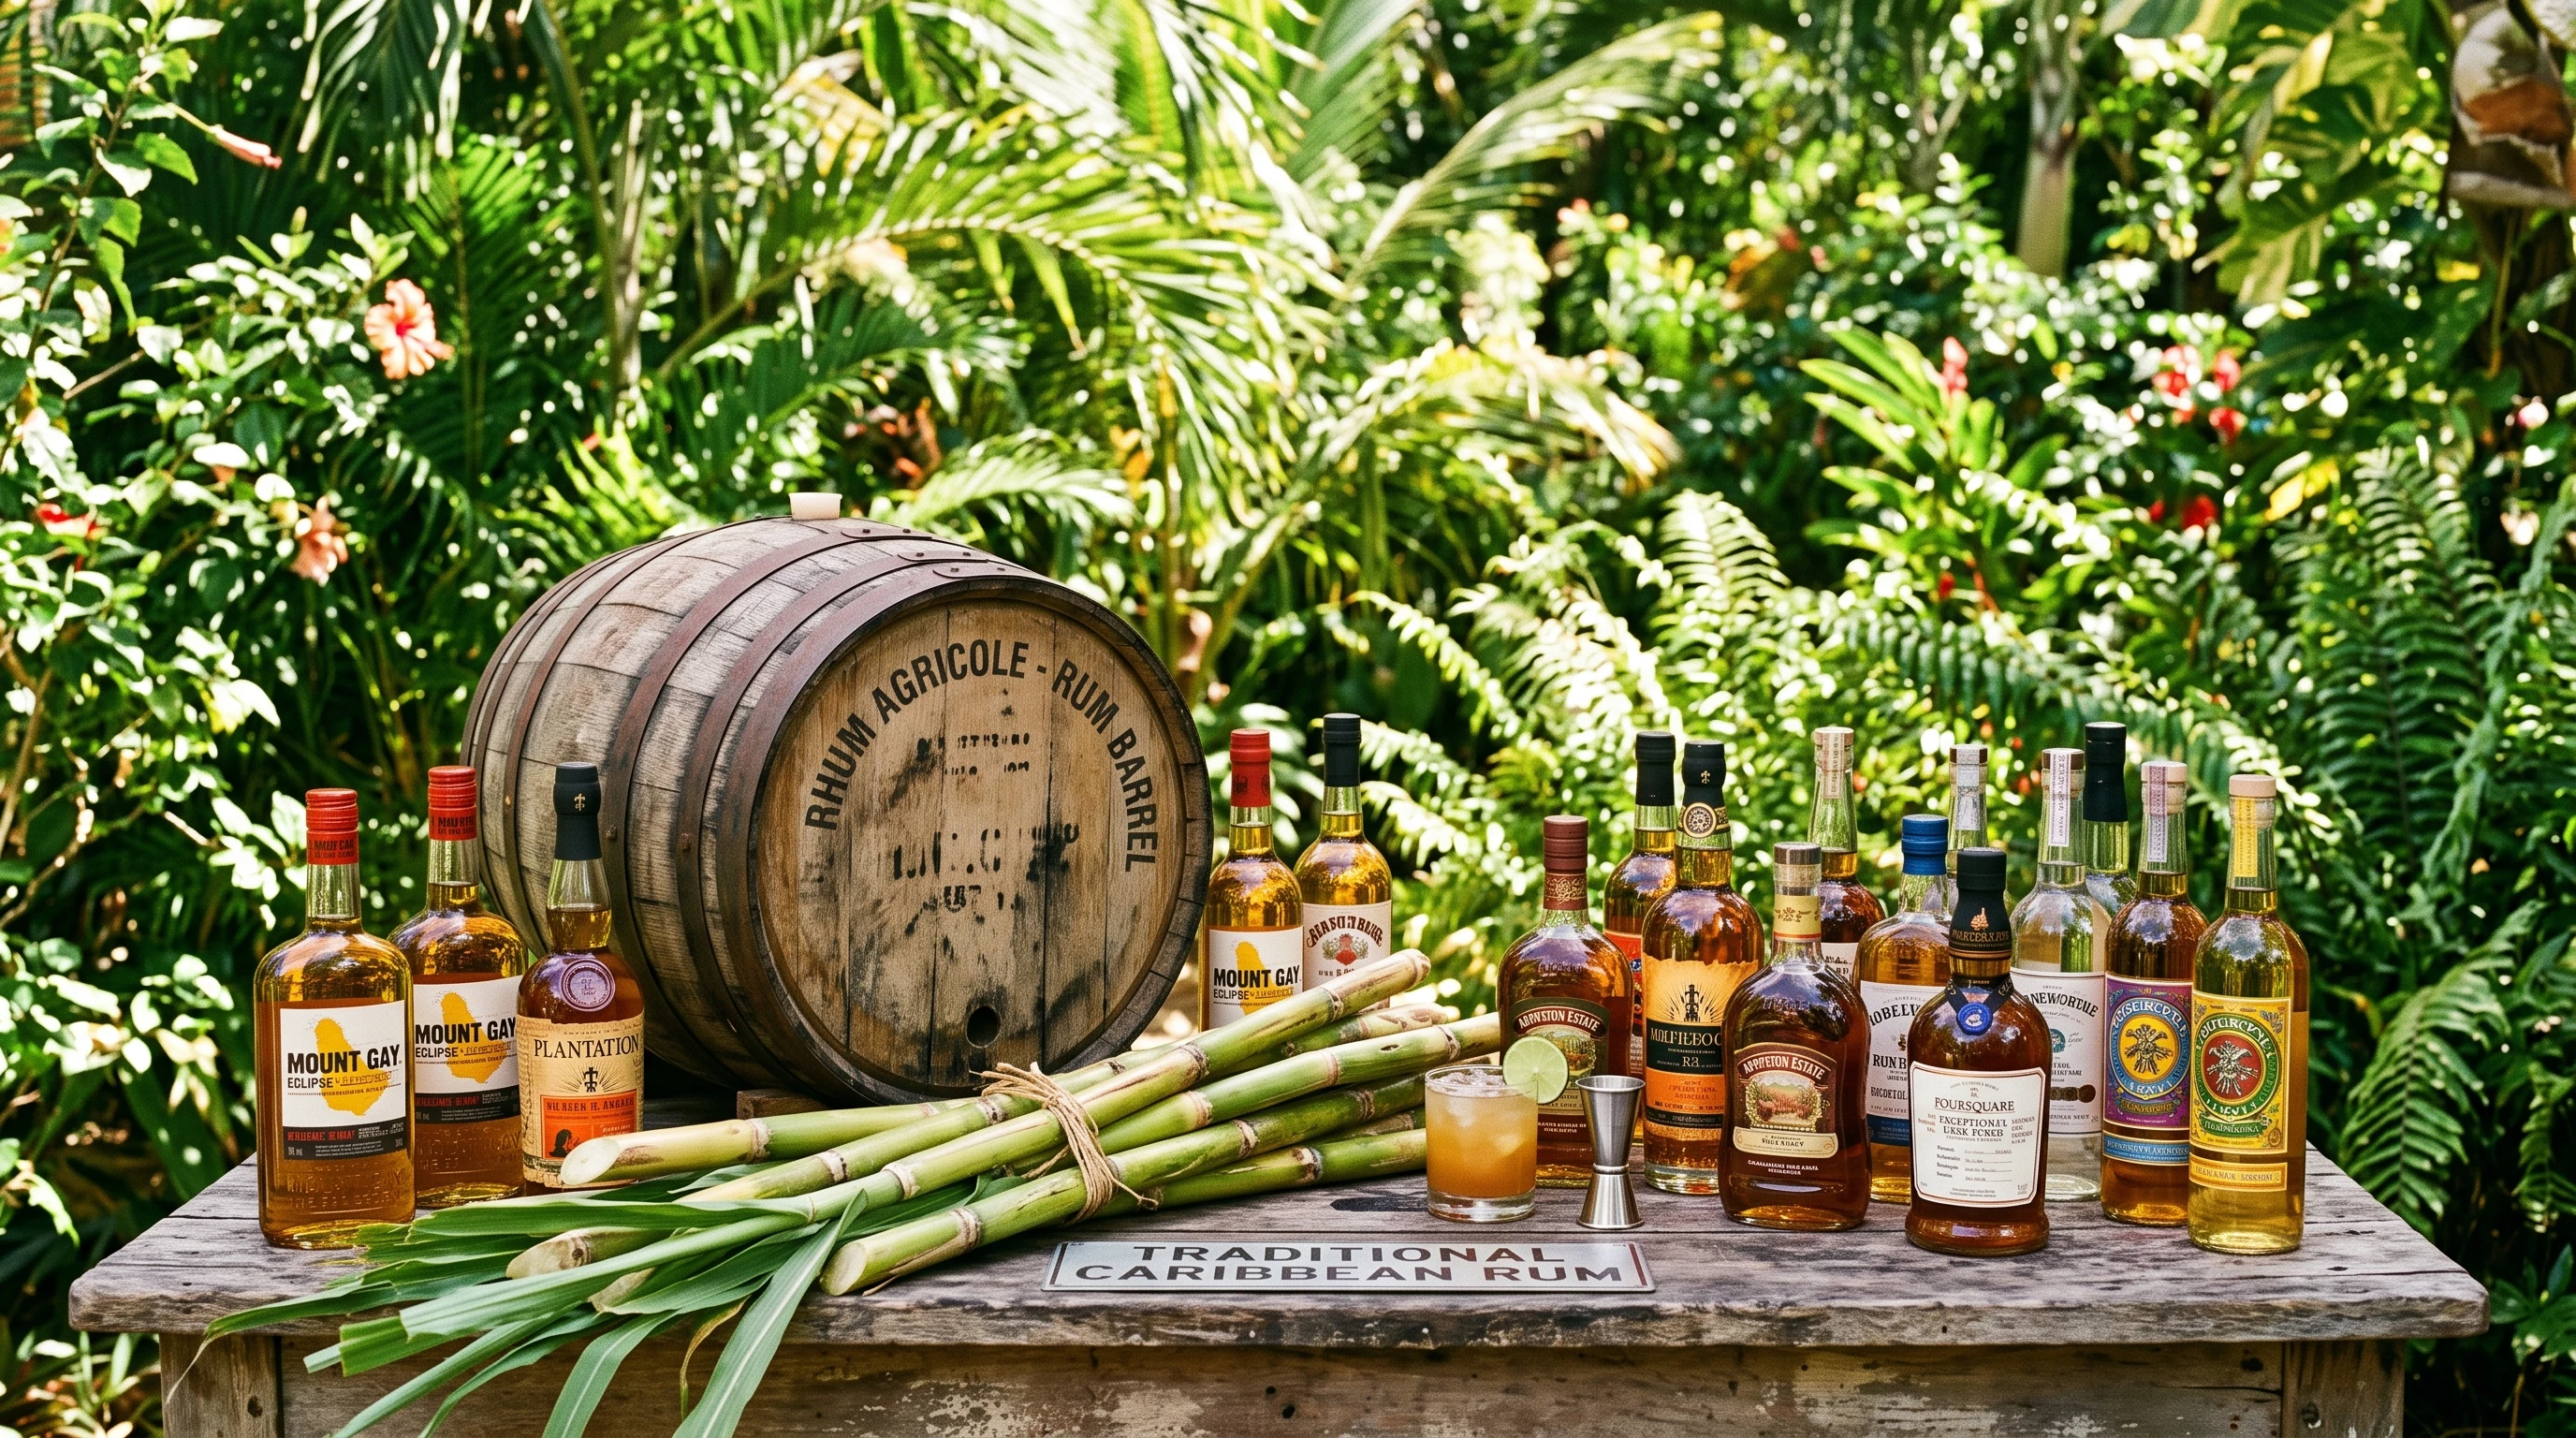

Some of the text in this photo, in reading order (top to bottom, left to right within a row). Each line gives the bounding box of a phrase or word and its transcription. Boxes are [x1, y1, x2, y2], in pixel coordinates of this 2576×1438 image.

[805, 712, 876, 831] RHUM
[871, 638, 1030, 725] AGRICOLE
[1051, 657, 1120, 735] RUM
[1106, 726, 1159, 873] BARREL
[1213, 968, 1271, 988] MOUNT
[1275, 964, 1300, 987] GAY
[1213, 989, 1250, 1000] ECLIPSE
[415, 1016, 517, 1045] MOUNT GAY
[415, 1047, 459, 1058] ECLIPSE
[534, 1034, 639, 1059] PLANTATION
[287, 1050, 361, 1075] MOUNT
[367, 1044, 401, 1070] GAY
[287, 1078, 334, 1089] ECLIPSE
[1934, 1096, 2015, 1114] FOURSQUARE
[1134, 1246, 1565, 1262] TRADITIONAL
[1076, 1265, 1622, 1282] CARIBBEAN RUM
